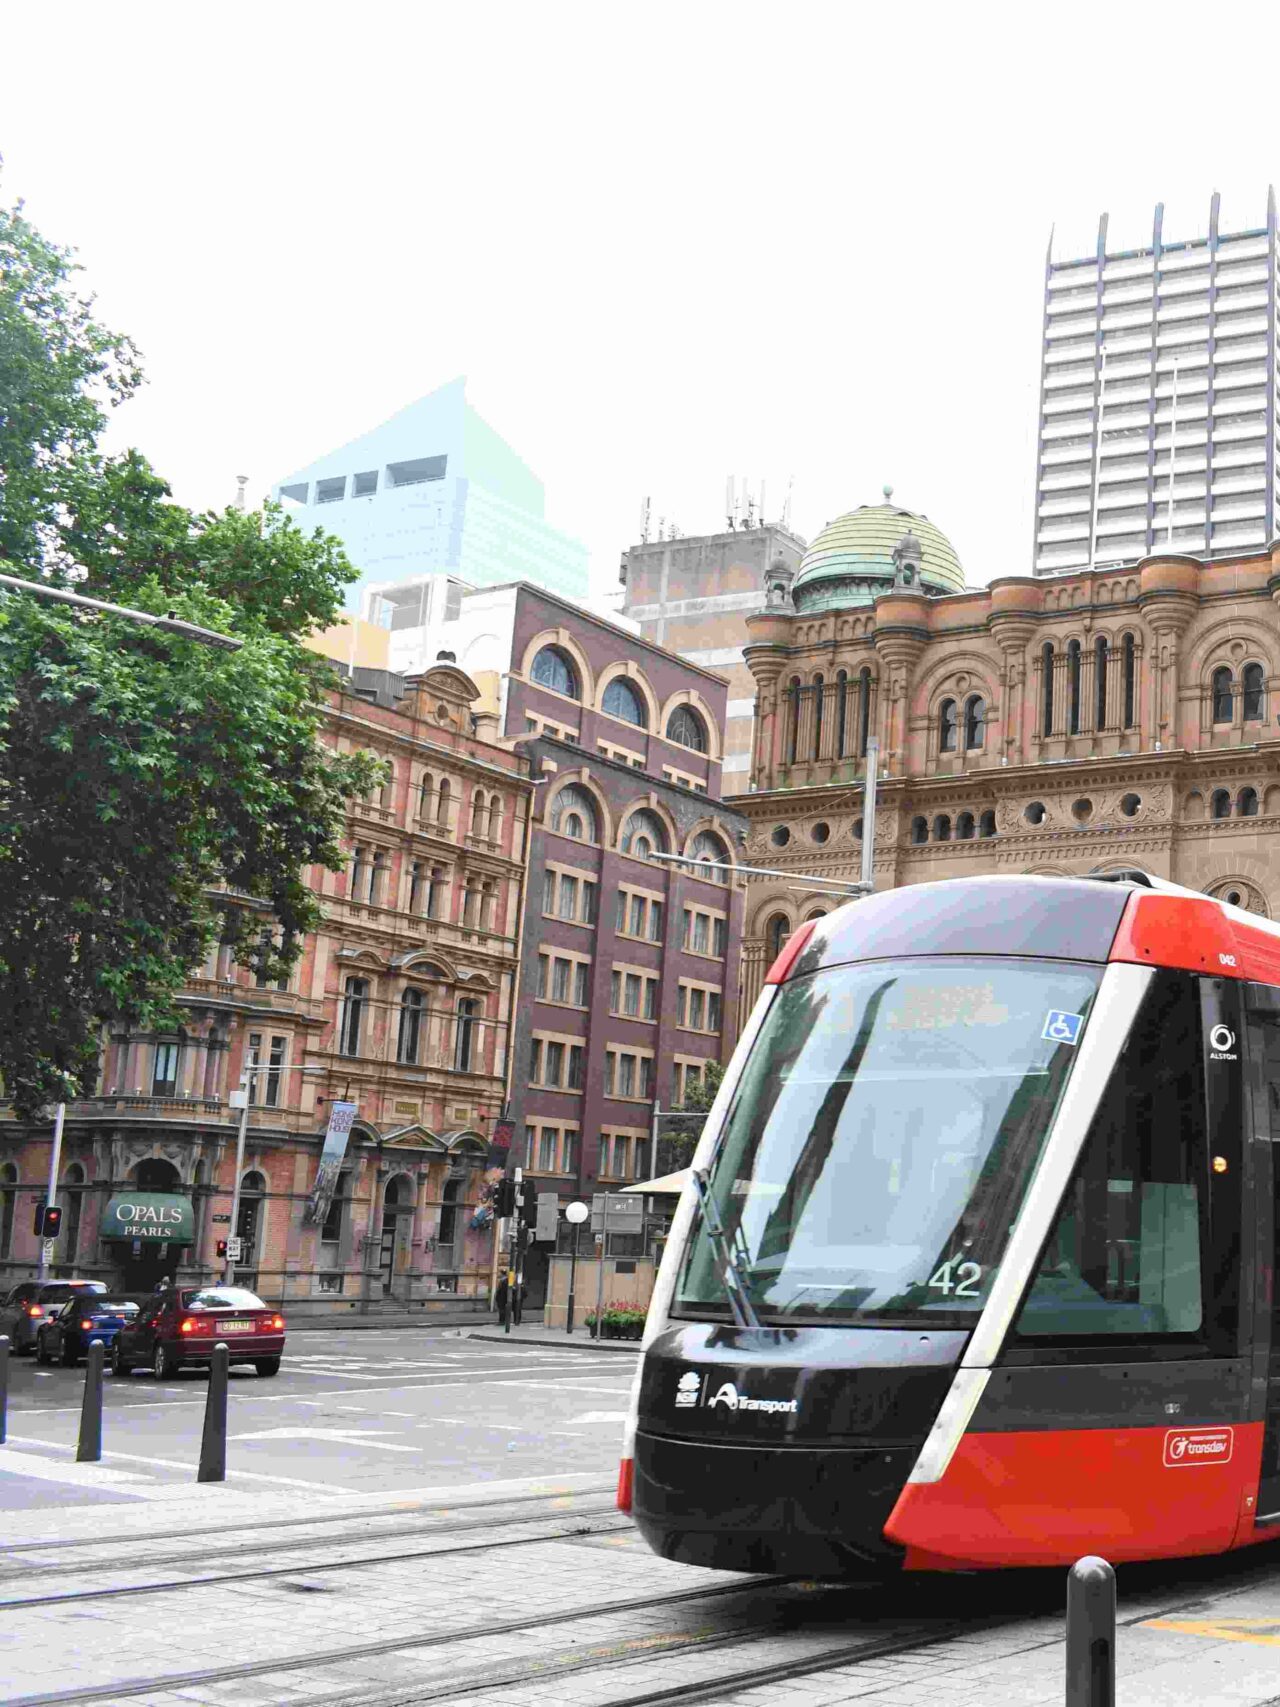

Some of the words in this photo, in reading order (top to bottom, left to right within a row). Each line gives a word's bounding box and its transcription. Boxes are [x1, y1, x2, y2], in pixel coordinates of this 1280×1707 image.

[1219, 954, 1236, 967] 042
[116, 1204, 182, 1223] OPALS
[124, 1226, 172, 1237] PEARLS
[928, 1261, 981, 1296] 42
[738, 1396, 798, 1413] Transport
[1187, 1441, 1227, 1455] transdev
